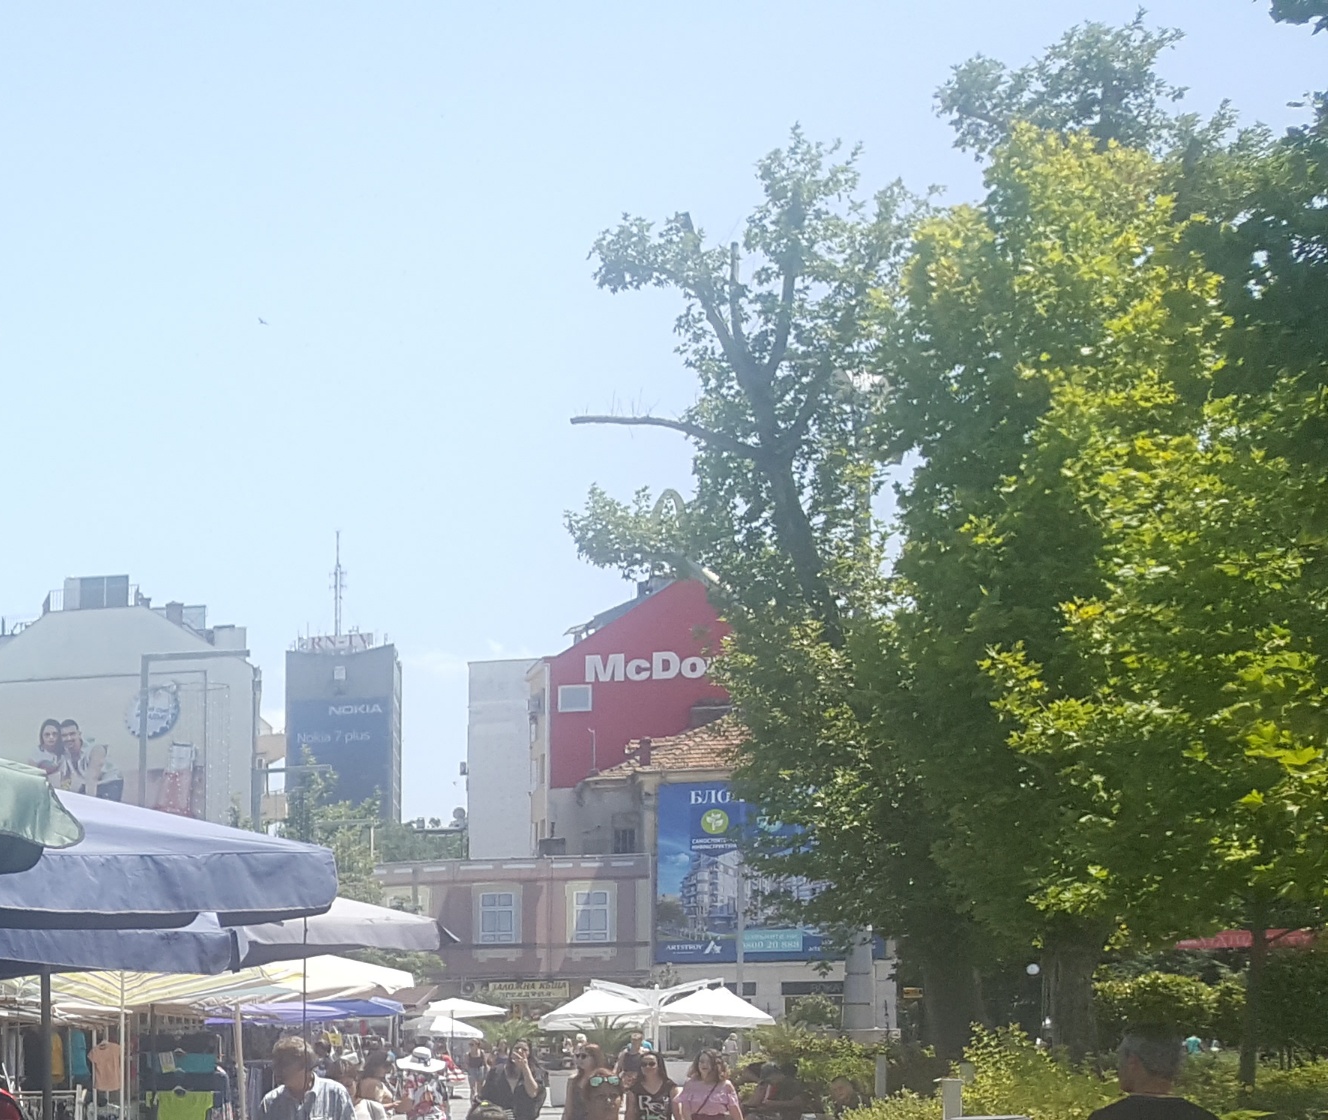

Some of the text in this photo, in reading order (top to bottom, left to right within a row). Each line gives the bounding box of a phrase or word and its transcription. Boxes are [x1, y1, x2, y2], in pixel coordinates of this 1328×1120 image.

[585, 652, 710, 682] McDo
[329, 704, 382, 715] NOKIA
[297, 729, 370, 743] Nokia 7 plus
[691, 789, 745, 804] БЛО
